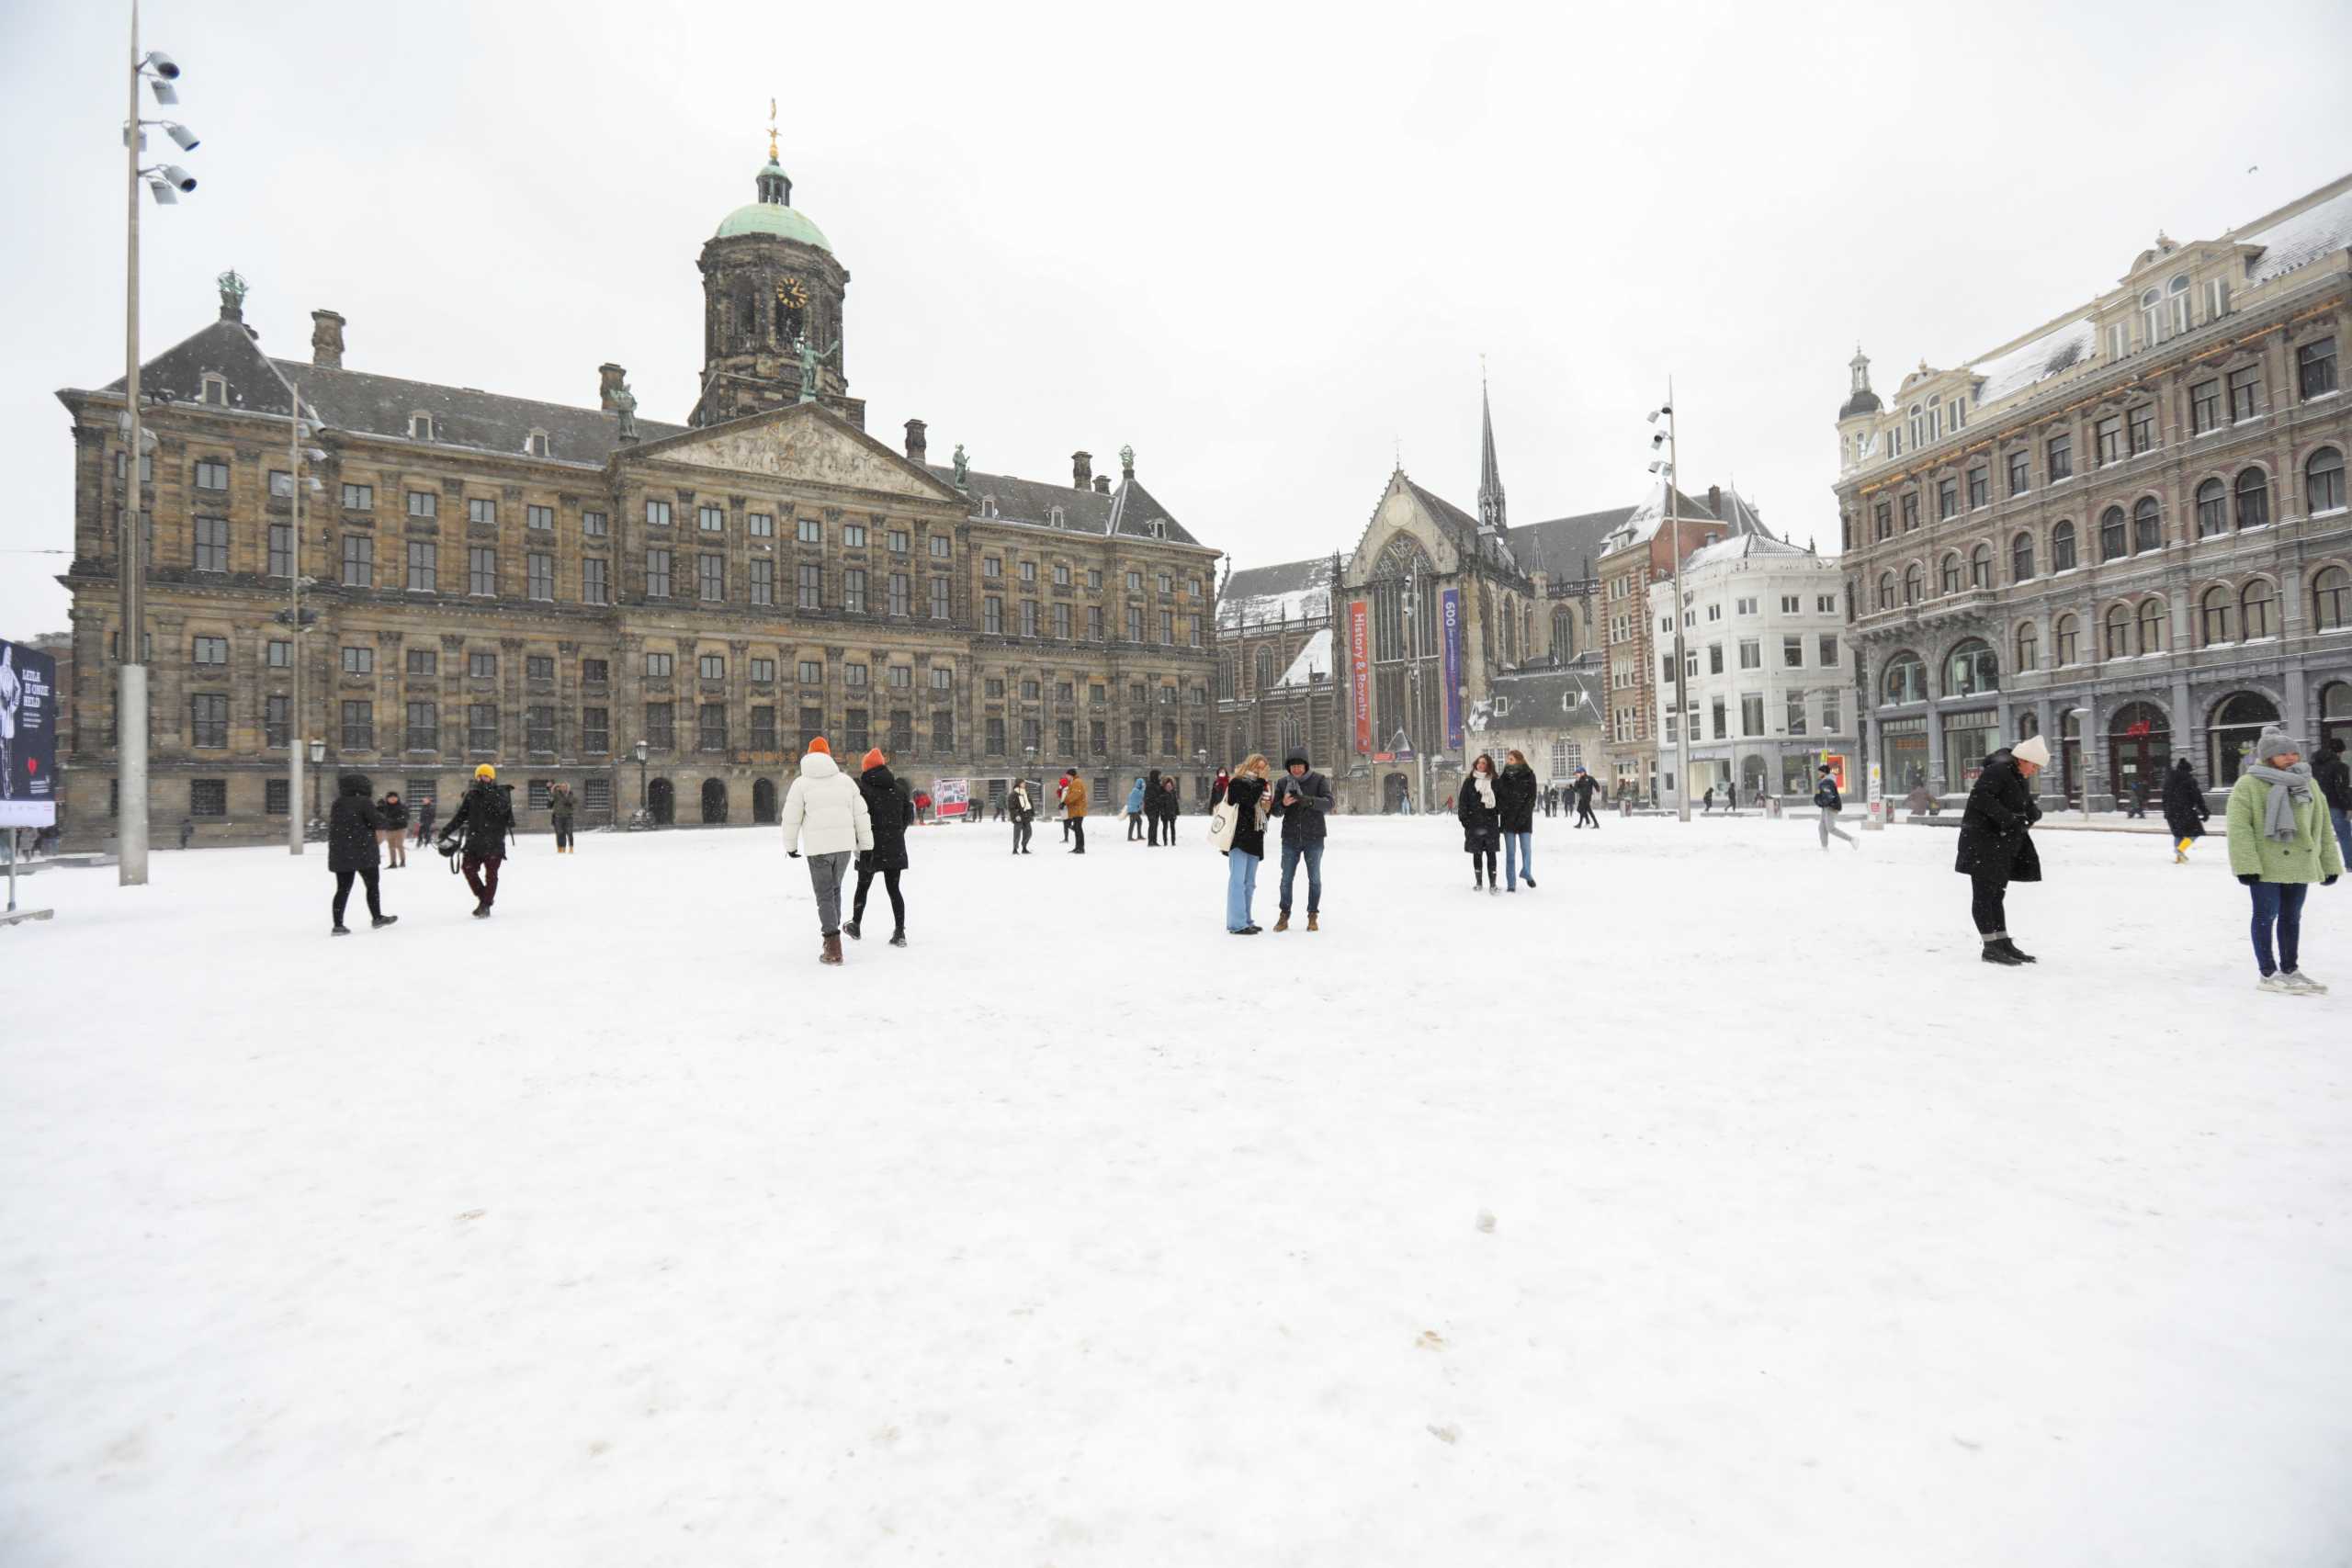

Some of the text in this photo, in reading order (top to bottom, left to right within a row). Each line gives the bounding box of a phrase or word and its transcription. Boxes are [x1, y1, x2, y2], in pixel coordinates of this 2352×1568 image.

[1445, 602, 1455, 626] 600
[1354, 614, 1367, 720] History & Royalty
